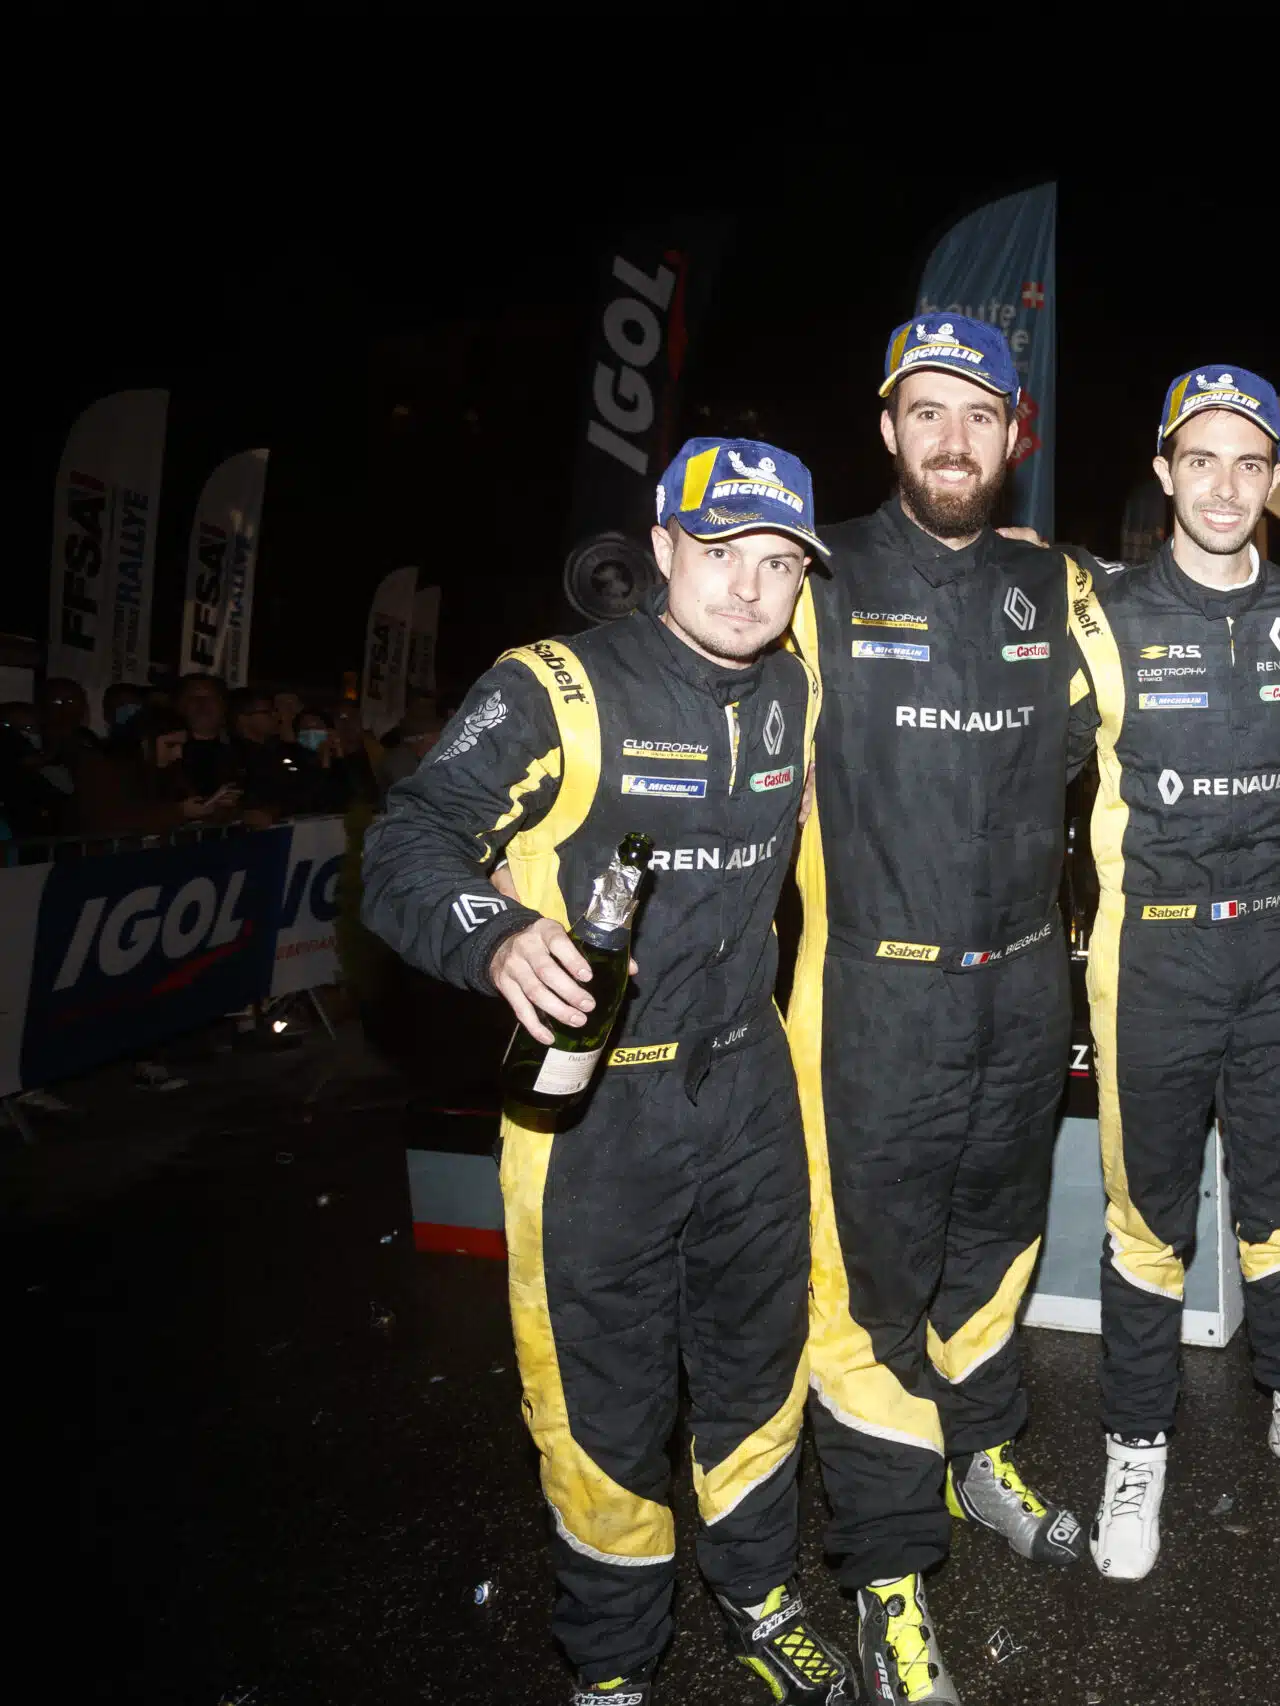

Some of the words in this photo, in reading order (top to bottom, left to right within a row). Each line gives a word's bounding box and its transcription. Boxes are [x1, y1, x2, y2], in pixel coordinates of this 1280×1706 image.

[587, 254, 676, 475] IGOL
[902, 345, 982, 366] MICHELIN
[1182, 392, 1260, 413] MICHELIN
[711, 482, 804, 514] MICHELIN
[875, 646, 923, 656] MICHELIN
[1016, 644, 1048, 658] Castrol
[896, 705, 1034, 731] RENAULT
[648, 783, 698, 793] MICHELIN
[764, 771, 791, 787] Castrol
[648, 836, 776, 871] RENAULT
[1148, 907, 1189, 918] Sabelt
[1239, 902, 1250, 915] R.
[1253, 898, 1263, 912] DI
[52, 868, 248, 992] IGOL
[884, 943, 933, 959] Sabelt
[613, 1046, 671, 1064] Sabelt
[752, 1598, 803, 1642] alpinest
